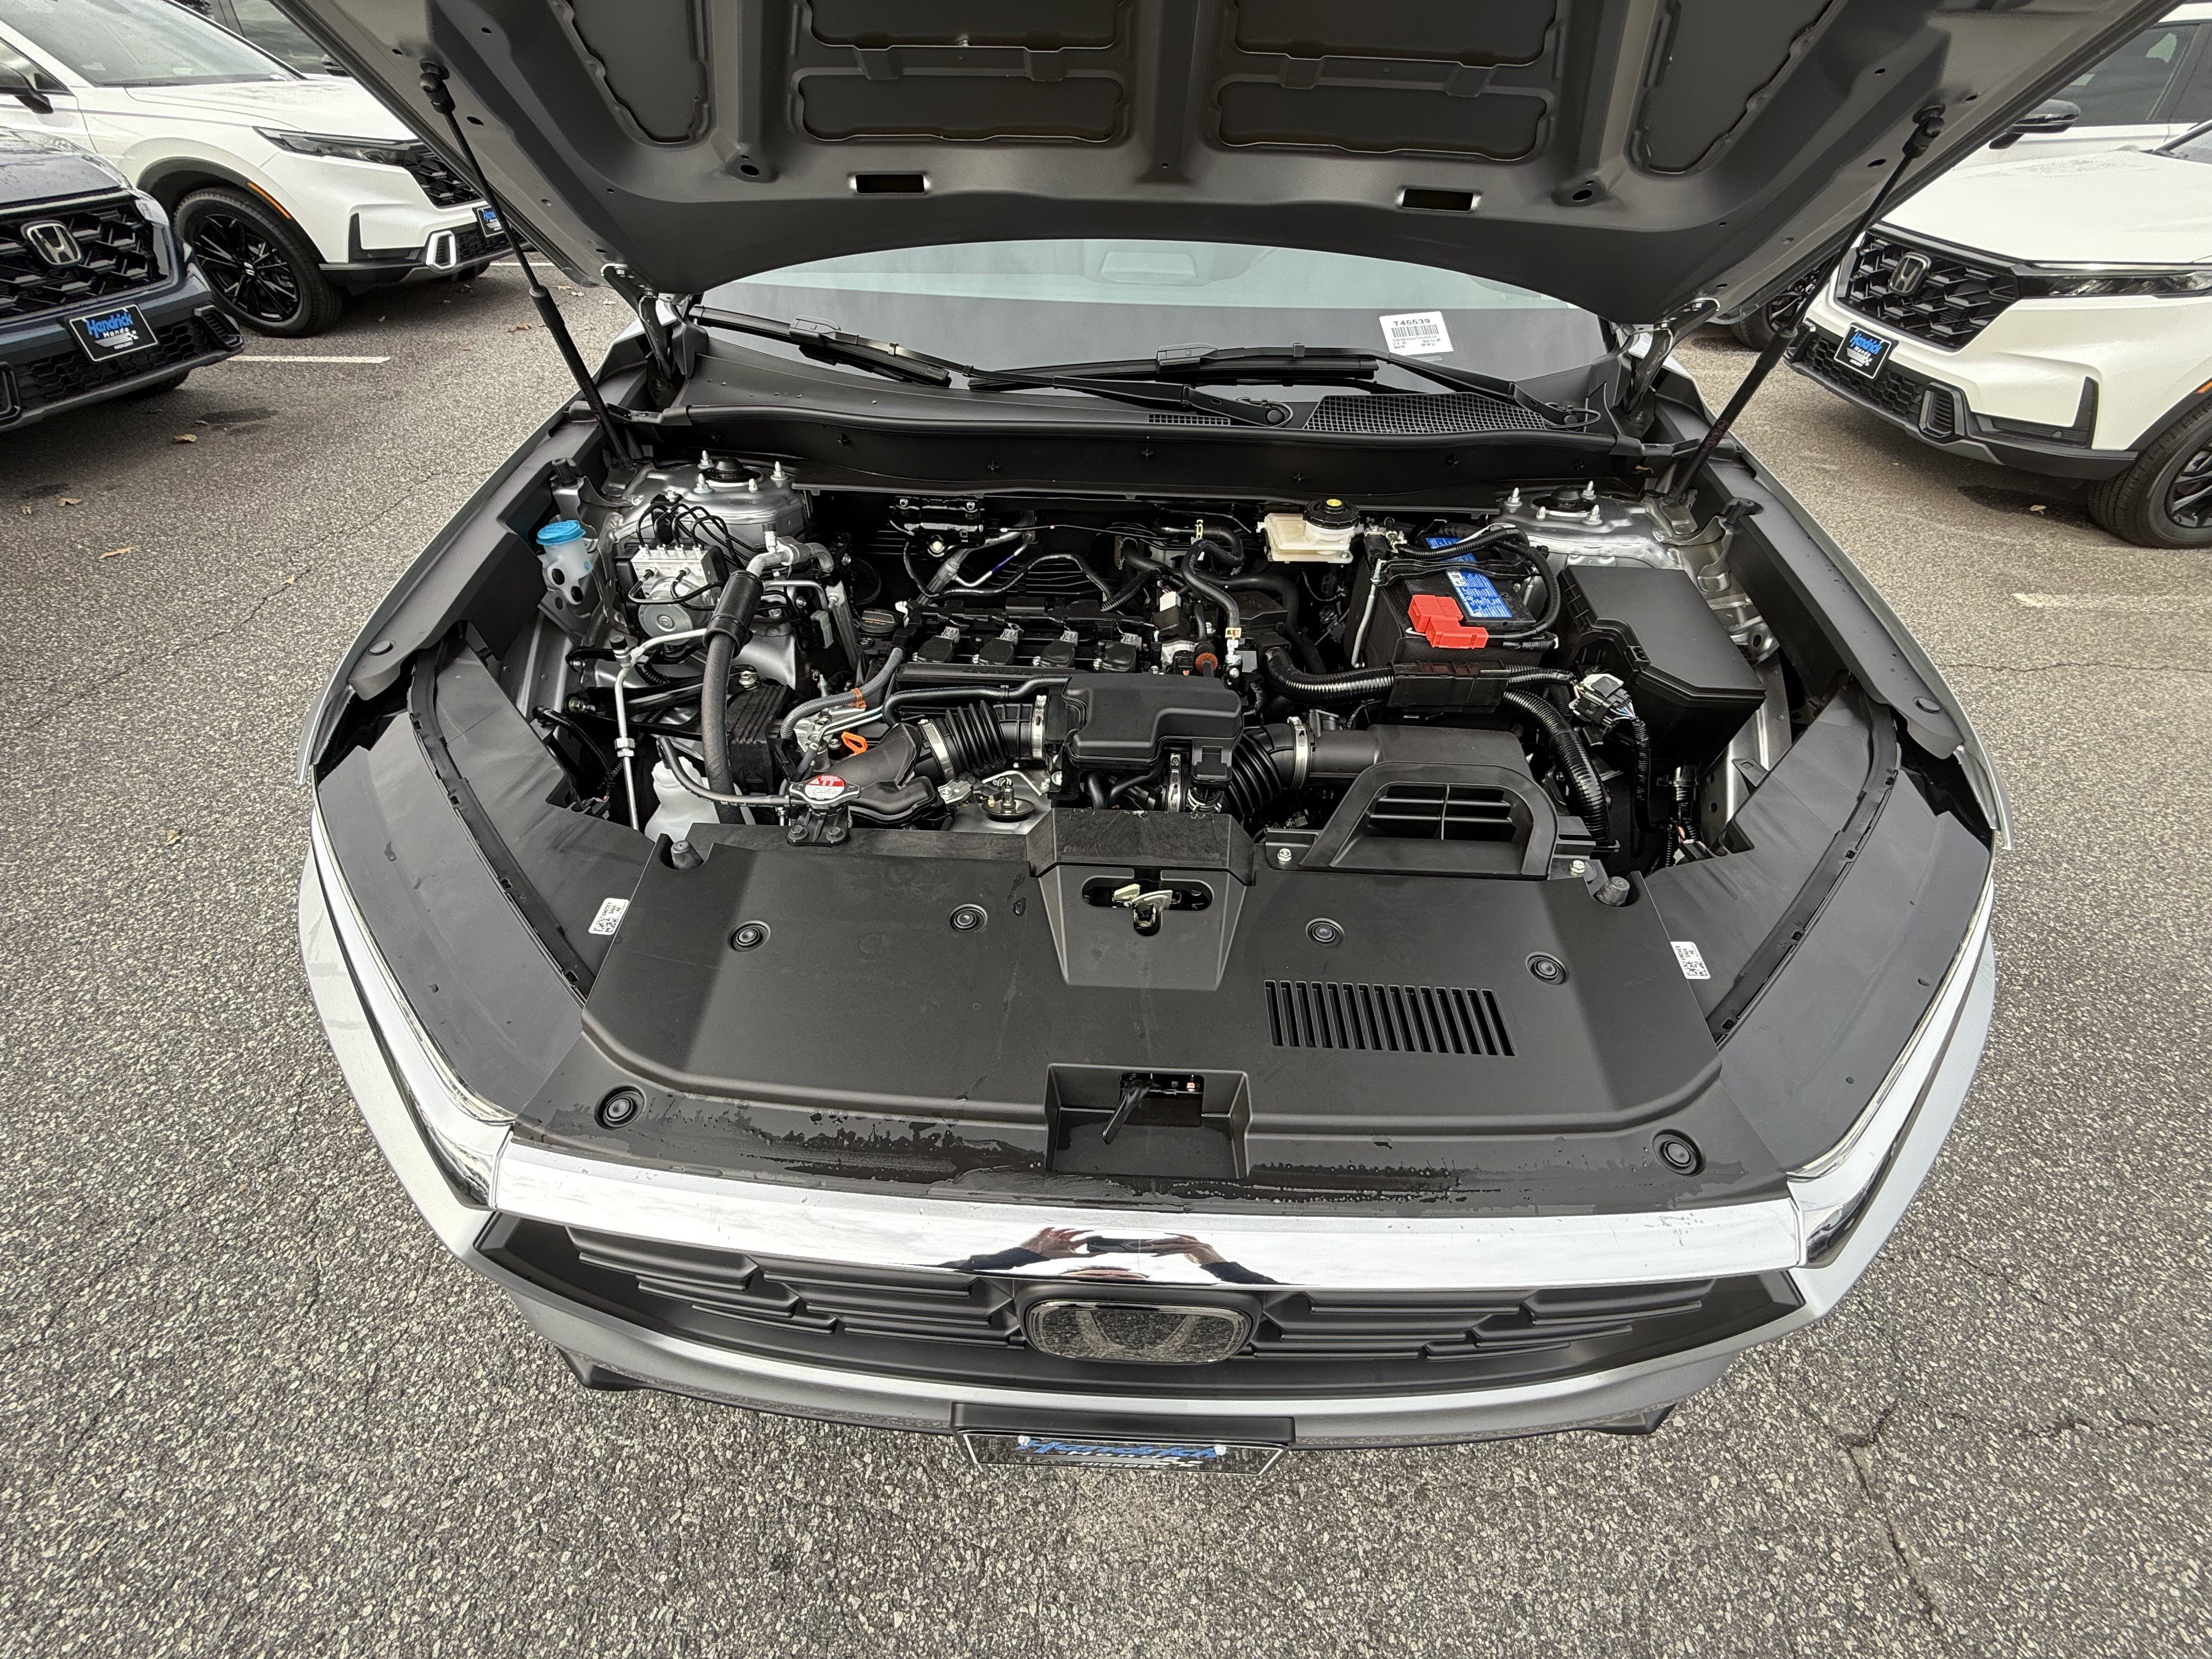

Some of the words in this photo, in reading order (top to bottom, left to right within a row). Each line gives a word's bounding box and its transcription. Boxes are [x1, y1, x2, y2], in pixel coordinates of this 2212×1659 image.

[86, 312, 133, 338] Hendrick
[103, 327, 129, 338] Honda
[1849, 332, 1883, 355] Hendrick
[1854, 346, 1871, 357] Honda
[1017, 1440, 1217, 1458] Hendrick
[1067, 1451, 1181, 1460] Honda
